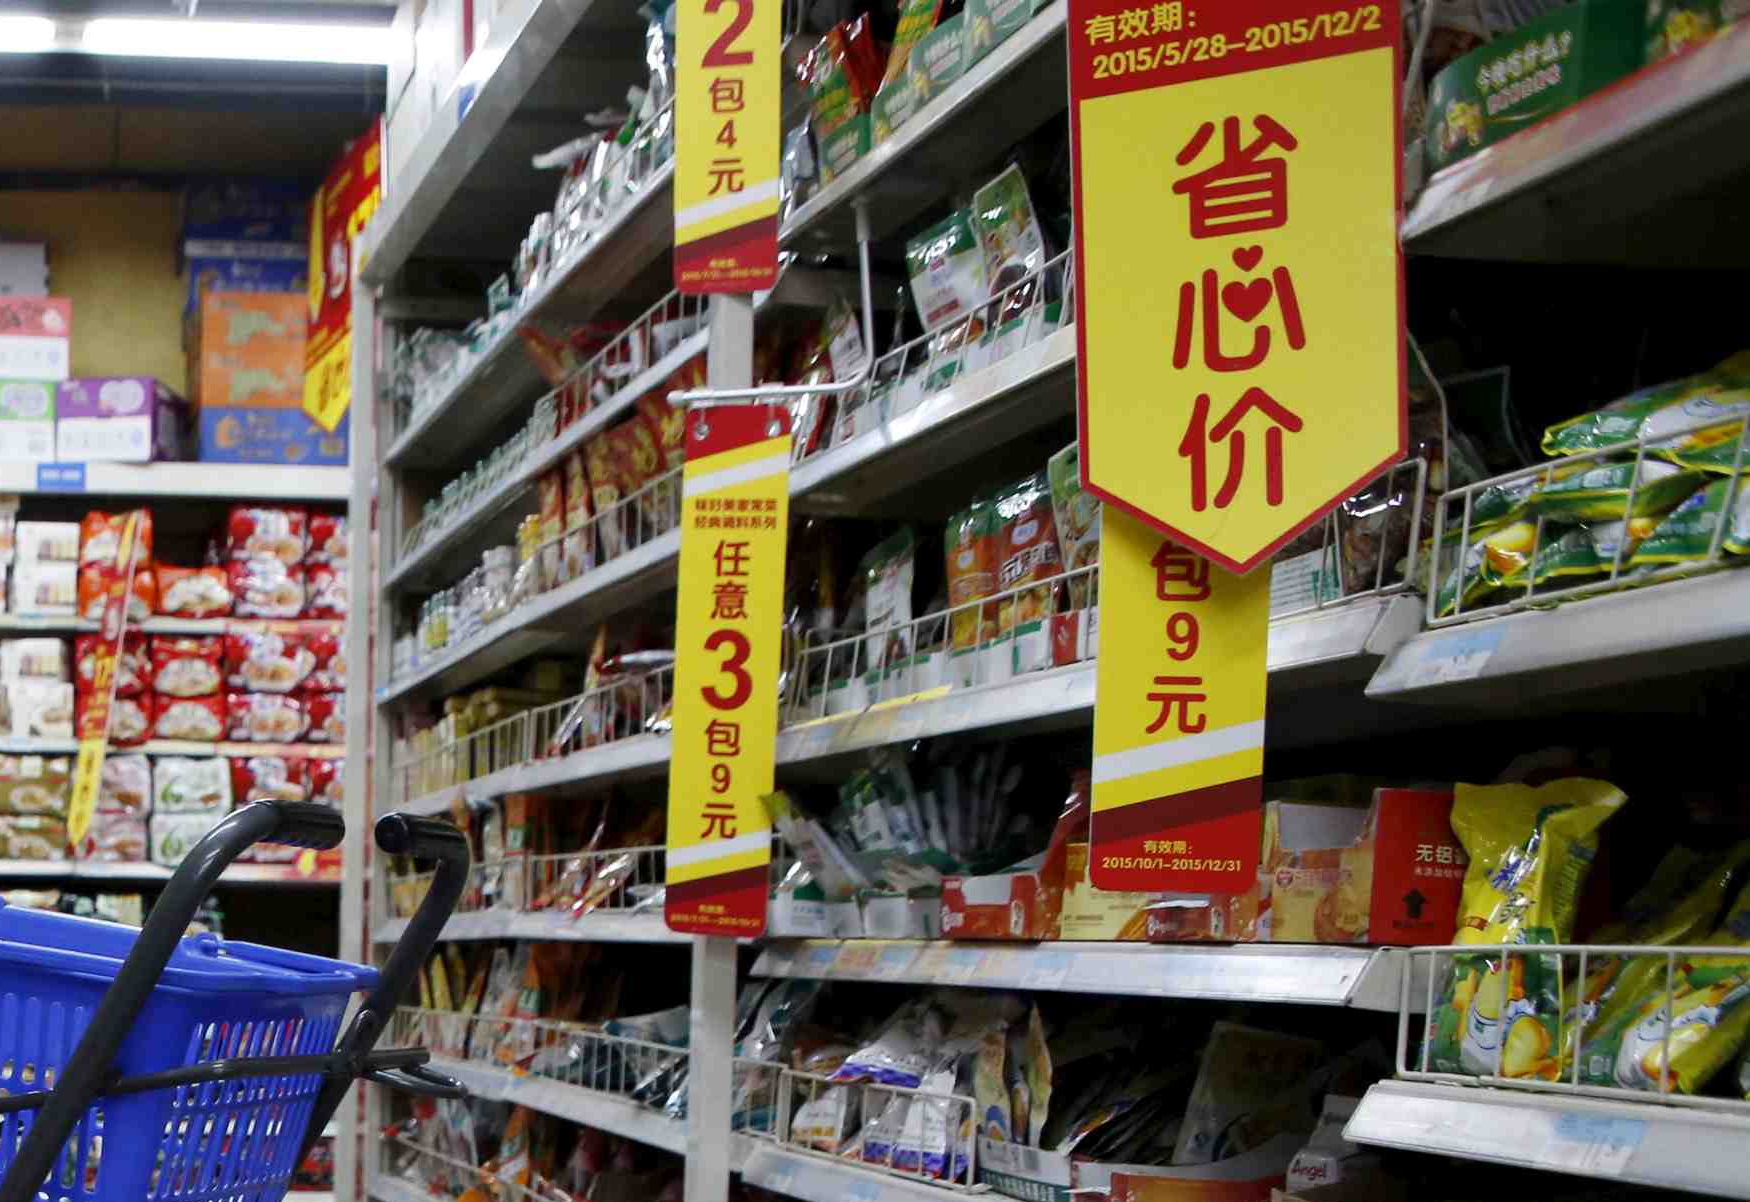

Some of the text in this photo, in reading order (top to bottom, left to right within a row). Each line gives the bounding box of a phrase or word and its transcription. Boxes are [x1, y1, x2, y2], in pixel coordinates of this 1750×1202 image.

[1084, 1, 1196, 45] 有效期:
[1172, 114, 1306, 512] 省心价
[1144, 840, 1193, 855] 有效期:
